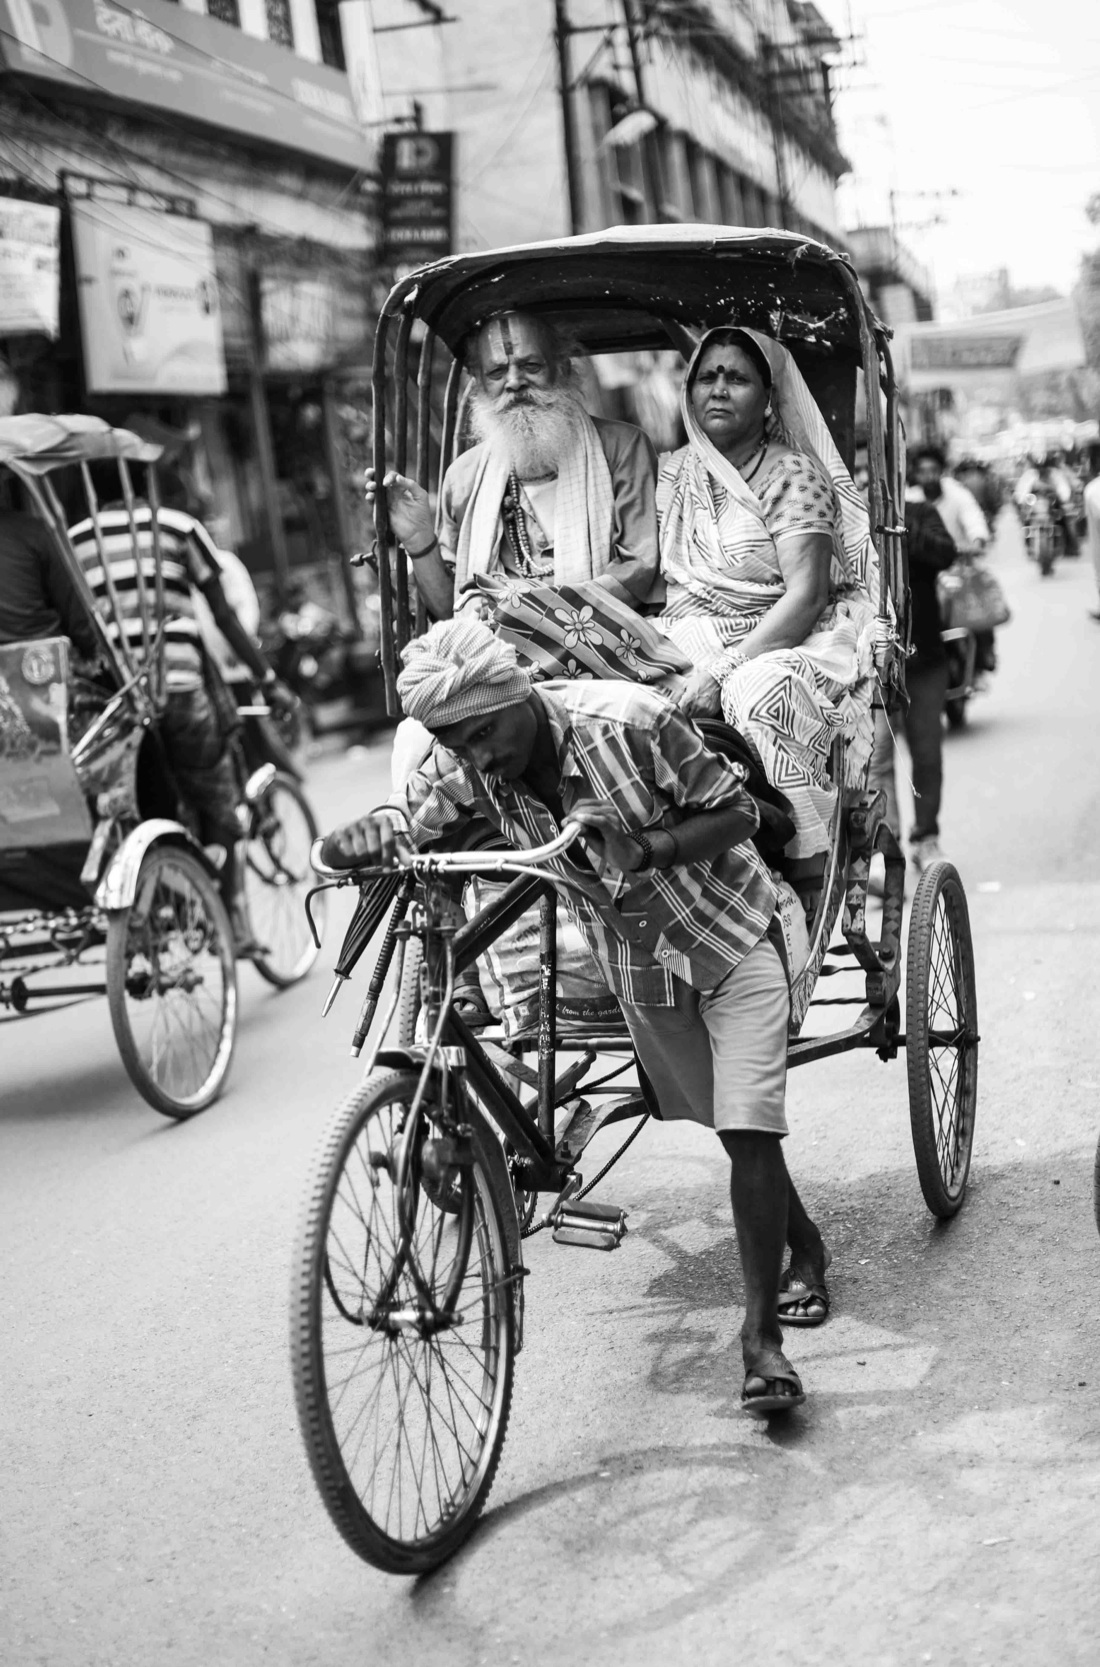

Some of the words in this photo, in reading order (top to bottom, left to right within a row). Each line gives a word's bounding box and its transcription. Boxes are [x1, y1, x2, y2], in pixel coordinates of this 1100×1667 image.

[561, 1005, 580, 1016] from
[582, 1008, 594, 1017] the
[597, 1004, 622, 1018] garde
